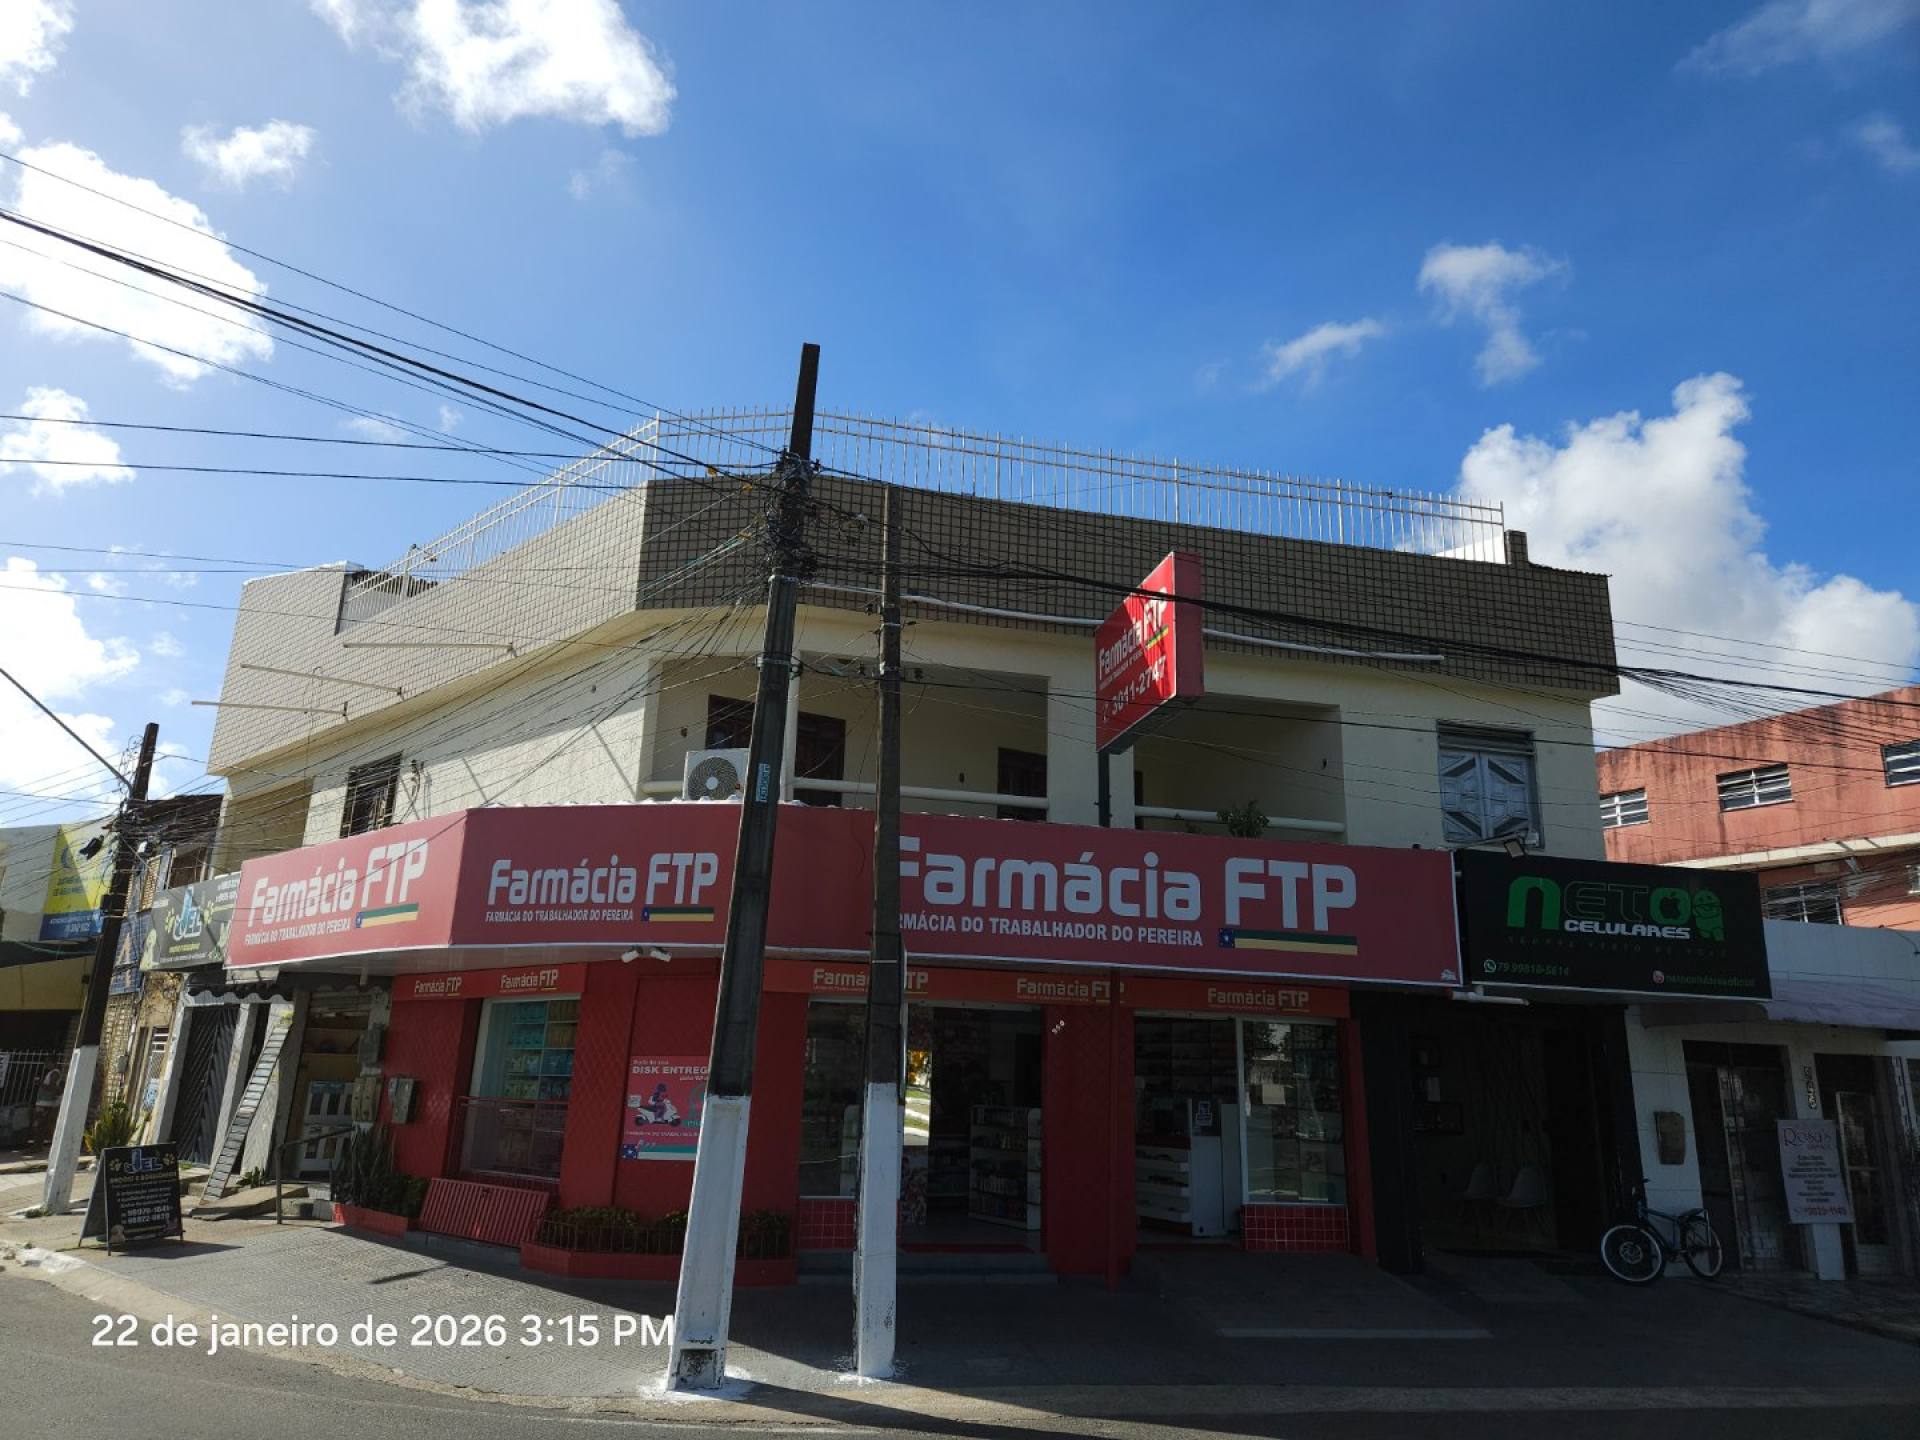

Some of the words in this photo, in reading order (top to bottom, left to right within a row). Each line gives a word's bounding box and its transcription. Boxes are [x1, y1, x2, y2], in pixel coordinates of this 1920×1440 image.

[1100, 617, 1142, 680] Farmácia
[1143, 587, 1168, 640] FTP
[248, 857, 358, 928] Farmácia
[361, 838, 429, 908] FTP
[488, 854, 637, 905] Farmácia
[645, 852, 719, 905] FTP
[1225, 857, 1357, 931] FTP
[522, 911, 533, 922] DO
[535, 910, 588, 921] TRABALHADOR
[589, 910, 600, 921] DO
[602, 909, 634, 921] PEREIRA
[900, 910, 957, 932] MÁCIA
[961, 916, 984, 933] DO
[989, 917, 1107, 941] TRABALHADOR
[1111, 925, 1133, 941] DO
[1138, 927, 1203, 946] PEREIRA
[1564, 918, 1692, 940] CELULARES
[445, 976, 462, 992] FTP
[539, 969, 559, 987] FTP
[813, 968, 866, 987] Farmá
[906, 971, 928, 990] TP
[1016, 978, 1089, 997] Farmácia
[1207, 987, 1276, 1006] Farmácia
[1278, 989, 1310, 1008] FTP
[632, 1066, 660, 1074] DISK
[662, 1066, 710, 1074] ENTREG
